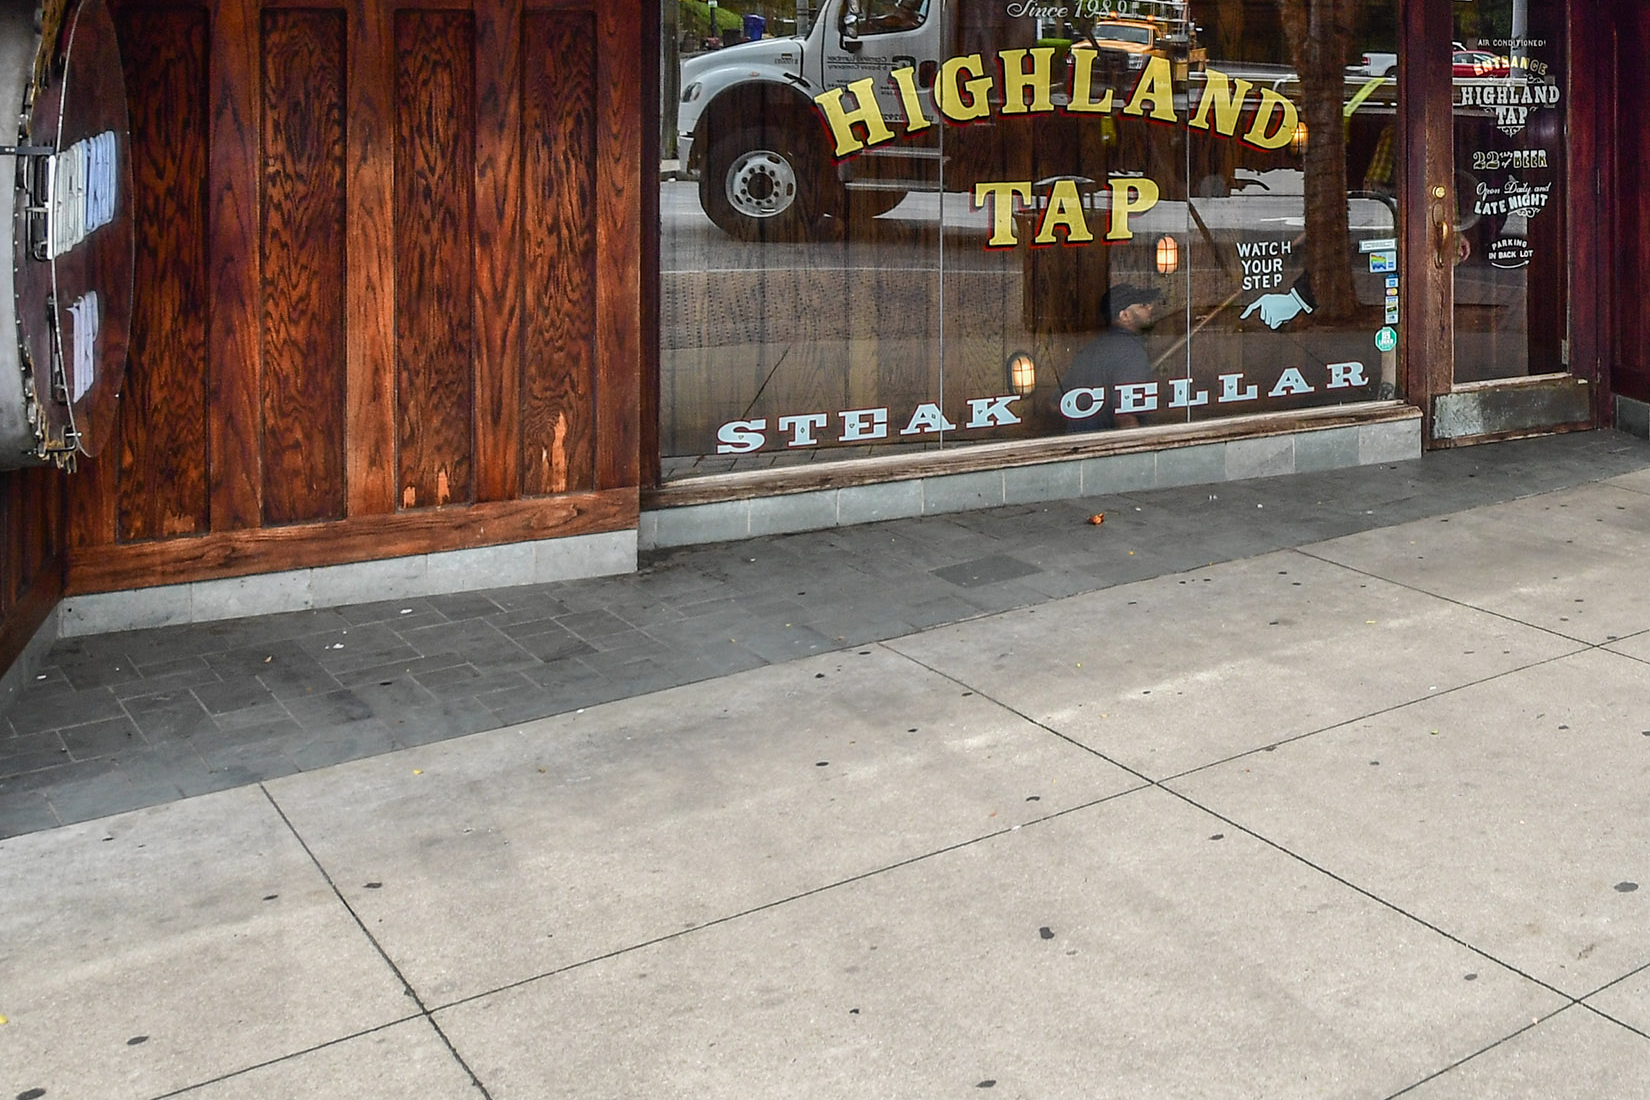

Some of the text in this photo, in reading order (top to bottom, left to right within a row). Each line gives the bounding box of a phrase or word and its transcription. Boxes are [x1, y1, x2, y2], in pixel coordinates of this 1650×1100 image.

[1477, 39, 1490, 47] AIR
[1473, 55, 1548, 76] ENTRANCE
[813, 47, 1302, 162] HIGHLAND
[1461, 85, 1560, 105] HIGHLAND
[1495, 106, 1528, 125] TAP
[1472, 151, 1500, 170] 22
[1513, 149, 1548, 169] BEER
[1476, 180, 1552, 201] Open Daily and
[973, 177, 1160, 247] TAP
[1474, 194, 1548, 215] LATE NIGHT
[1236, 241, 1291, 258] WATCH
[1491, 238, 1528, 251] PARKING
[1520, 249, 1534, 258] LOT
[1241, 258, 1283, 275] YOUR
[1242, 273, 1283, 290] STEP
[716, 361, 1370, 455] STEAK CELLAR
